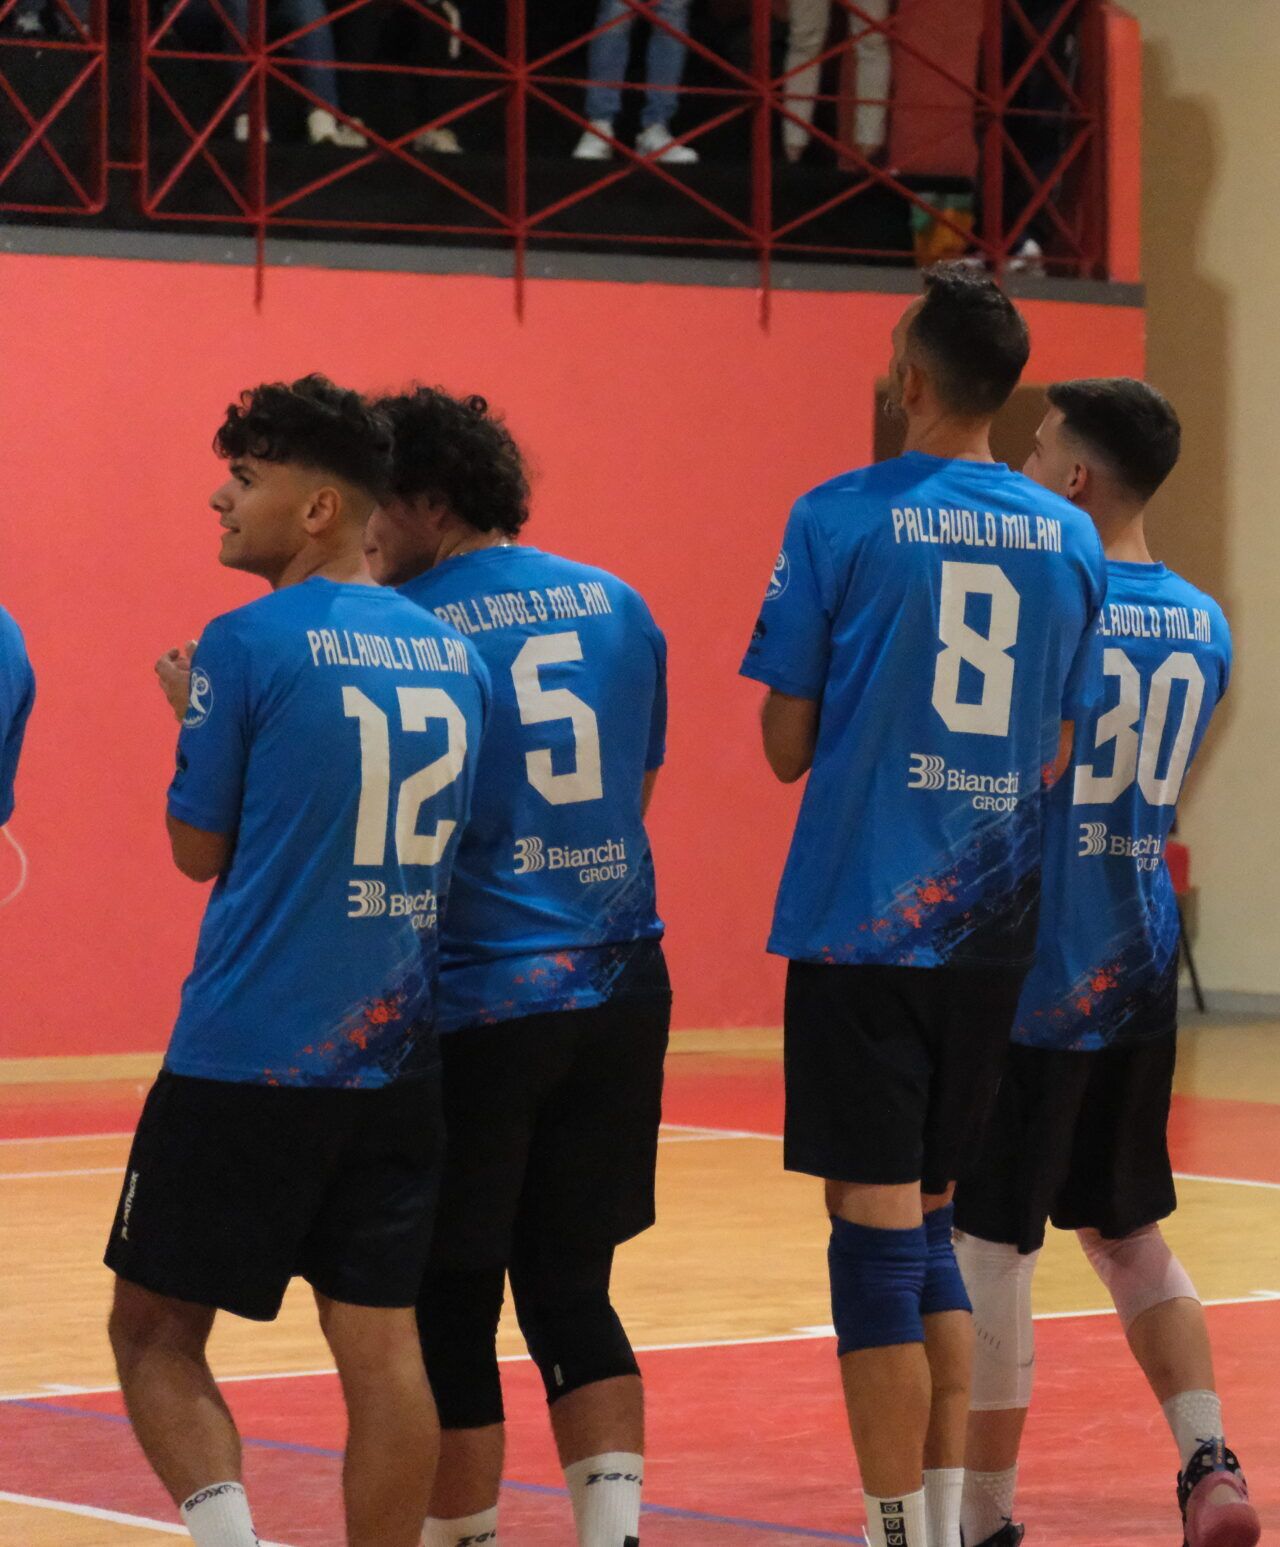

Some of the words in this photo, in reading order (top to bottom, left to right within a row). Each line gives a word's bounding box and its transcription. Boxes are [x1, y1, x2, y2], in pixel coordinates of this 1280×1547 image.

[891, 507, 997, 547] PALLAVOLO
[1001, 513, 1062, 553] MILANI
[545, 582, 612, 619] MILANI
[1163, 606, 1211, 643] MILANI
[306, 629, 414, 671] PALLAVOLO
[410, 636, 469, 675] MILANI
[931, 560, 1021, 737] 8
[510, 631, 603, 806] 5
[1072, 648, 1205, 806] 30
[341, 685, 467, 867] 12
[946, 769, 1019, 794] Bianchi
[972, 795, 1018, 811] GROUP
[547, 838, 626, 870] Bianchi
[579, 863, 628, 884] GROUP
